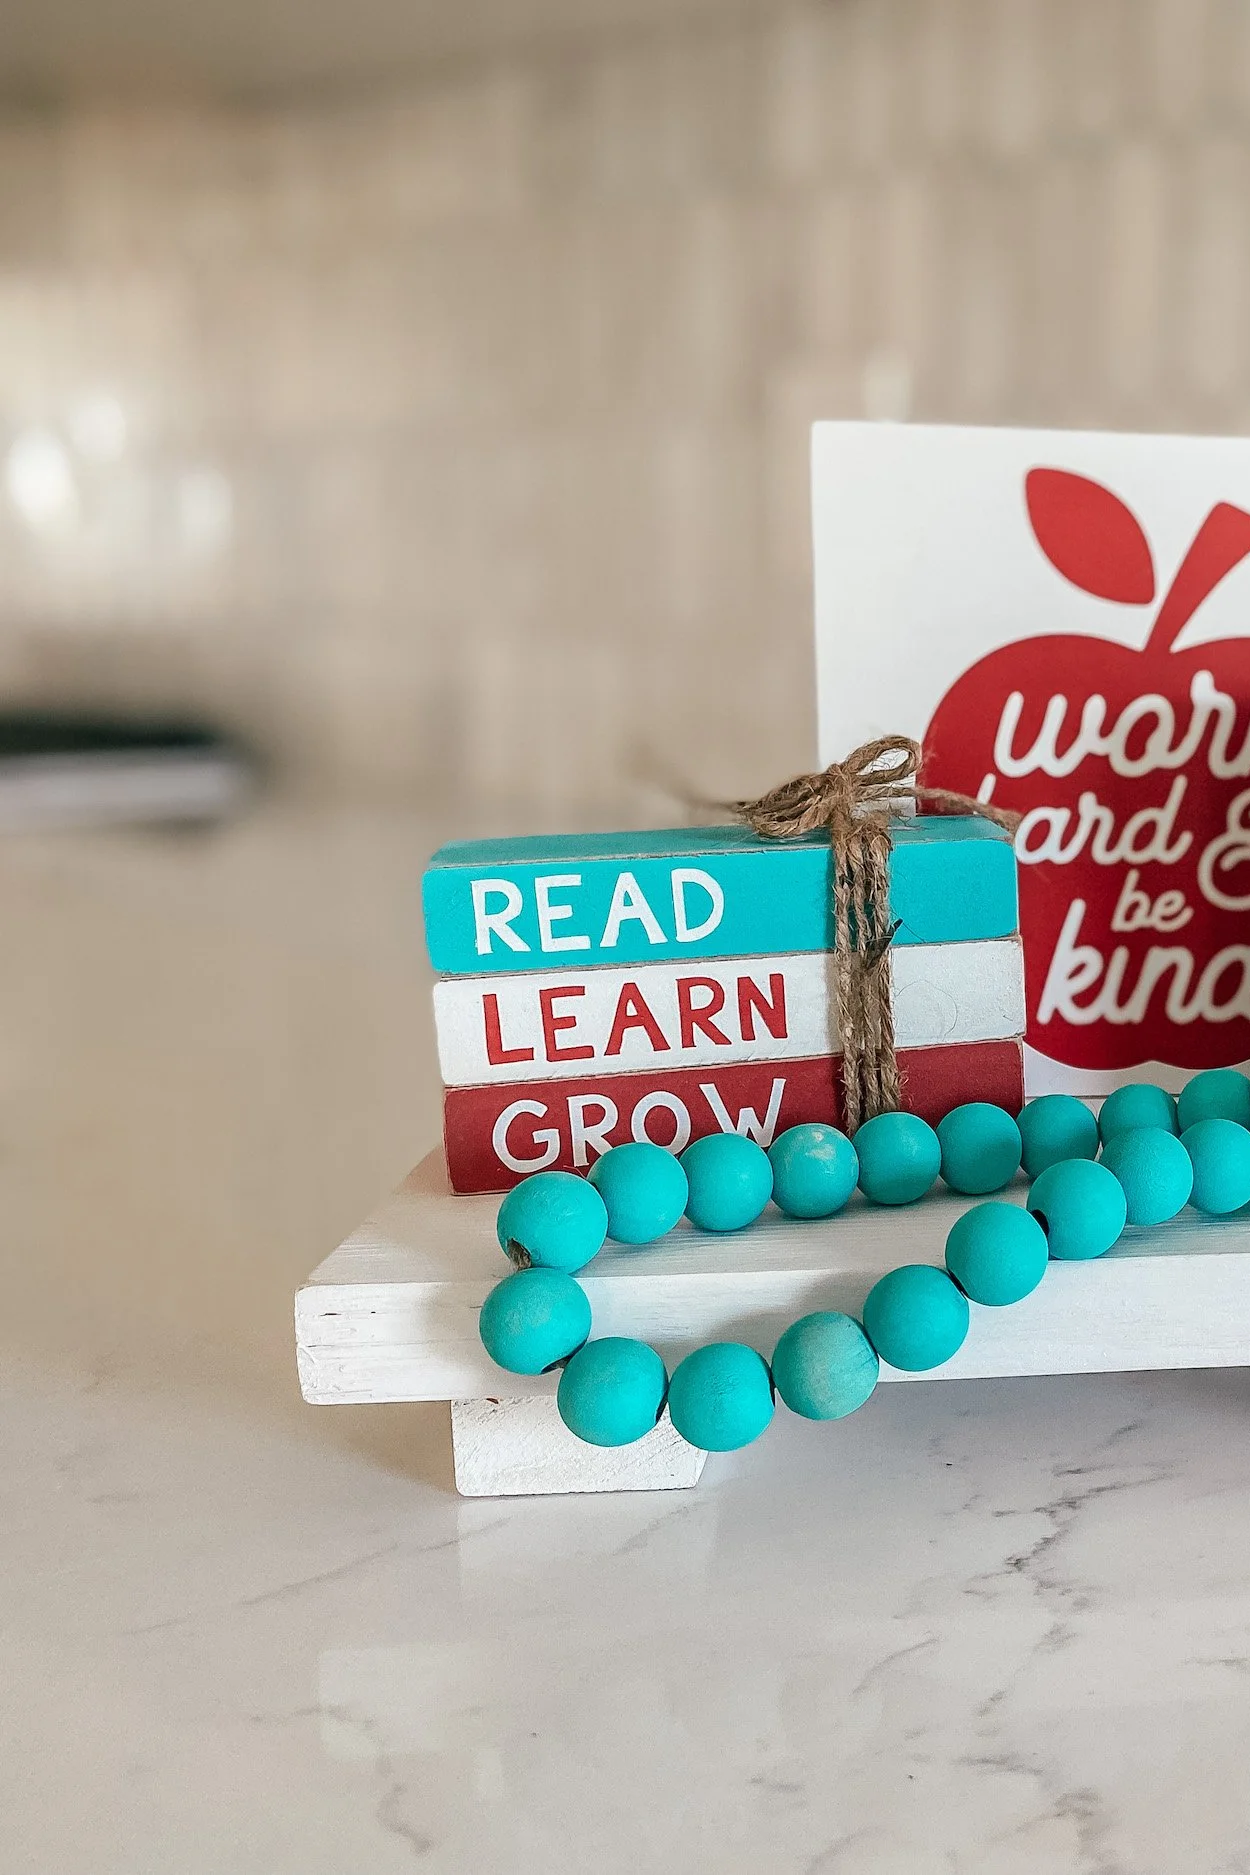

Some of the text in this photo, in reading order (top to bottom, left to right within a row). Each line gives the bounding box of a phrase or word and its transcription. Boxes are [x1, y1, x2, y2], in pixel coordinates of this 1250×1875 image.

[976, 772, 1193, 865] ard
[470, 867, 725, 956] READ
[1111, 868, 1194, 932] be
[481, 972, 789, 1066] LEARN
[491, 1077, 787, 1174] GROW
